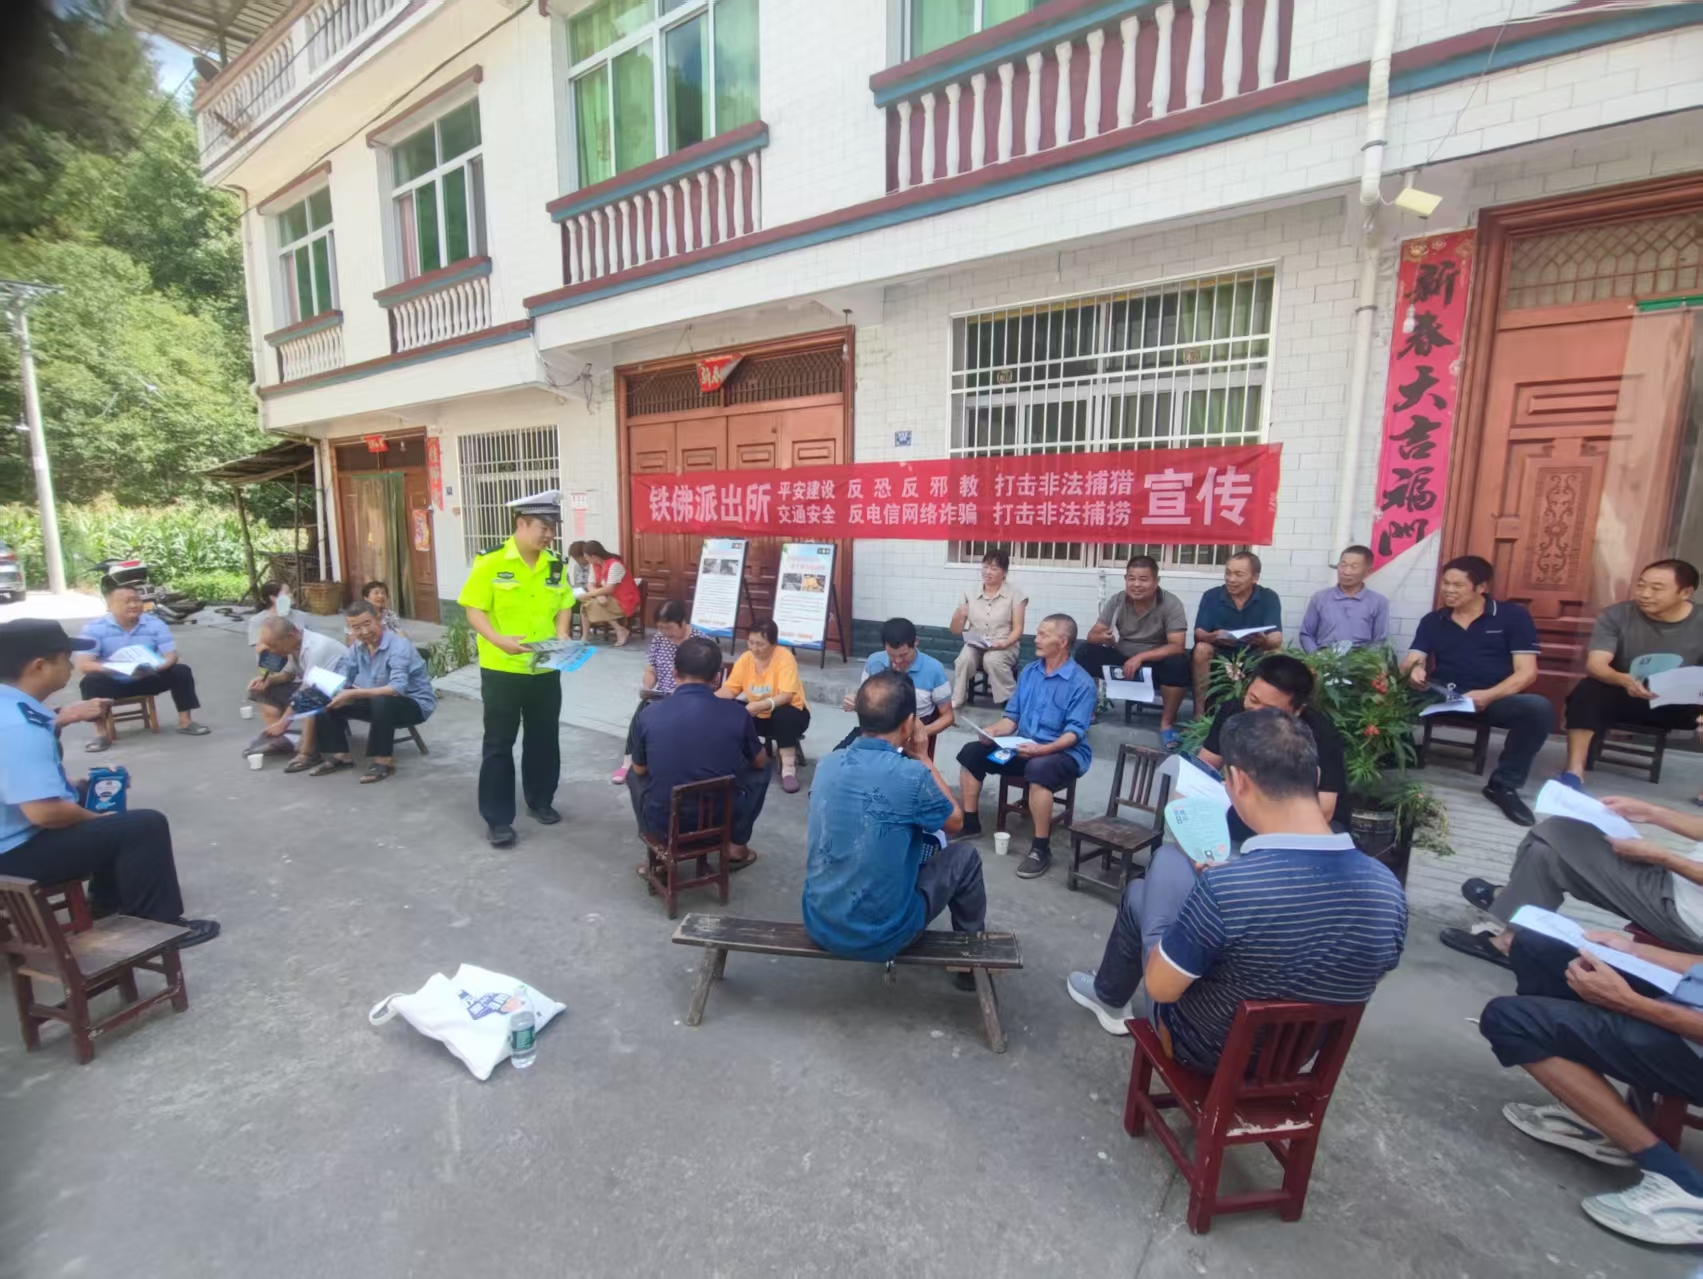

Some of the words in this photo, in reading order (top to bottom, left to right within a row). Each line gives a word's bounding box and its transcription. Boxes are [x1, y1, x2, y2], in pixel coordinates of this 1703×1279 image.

[777, 480, 835, 500] 平安建设
[995, 470, 1134, 497] 打击非法捕猎
[1142, 465, 1253, 526] 宣传
[649, 483, 771, 523] 铁佛派出所
[777, 504, 835, 524] 交通安全
[849, 503, 977, 525] 反电信网络诈骗
[993, 501, 1131, 526] 打击非法捕捞
